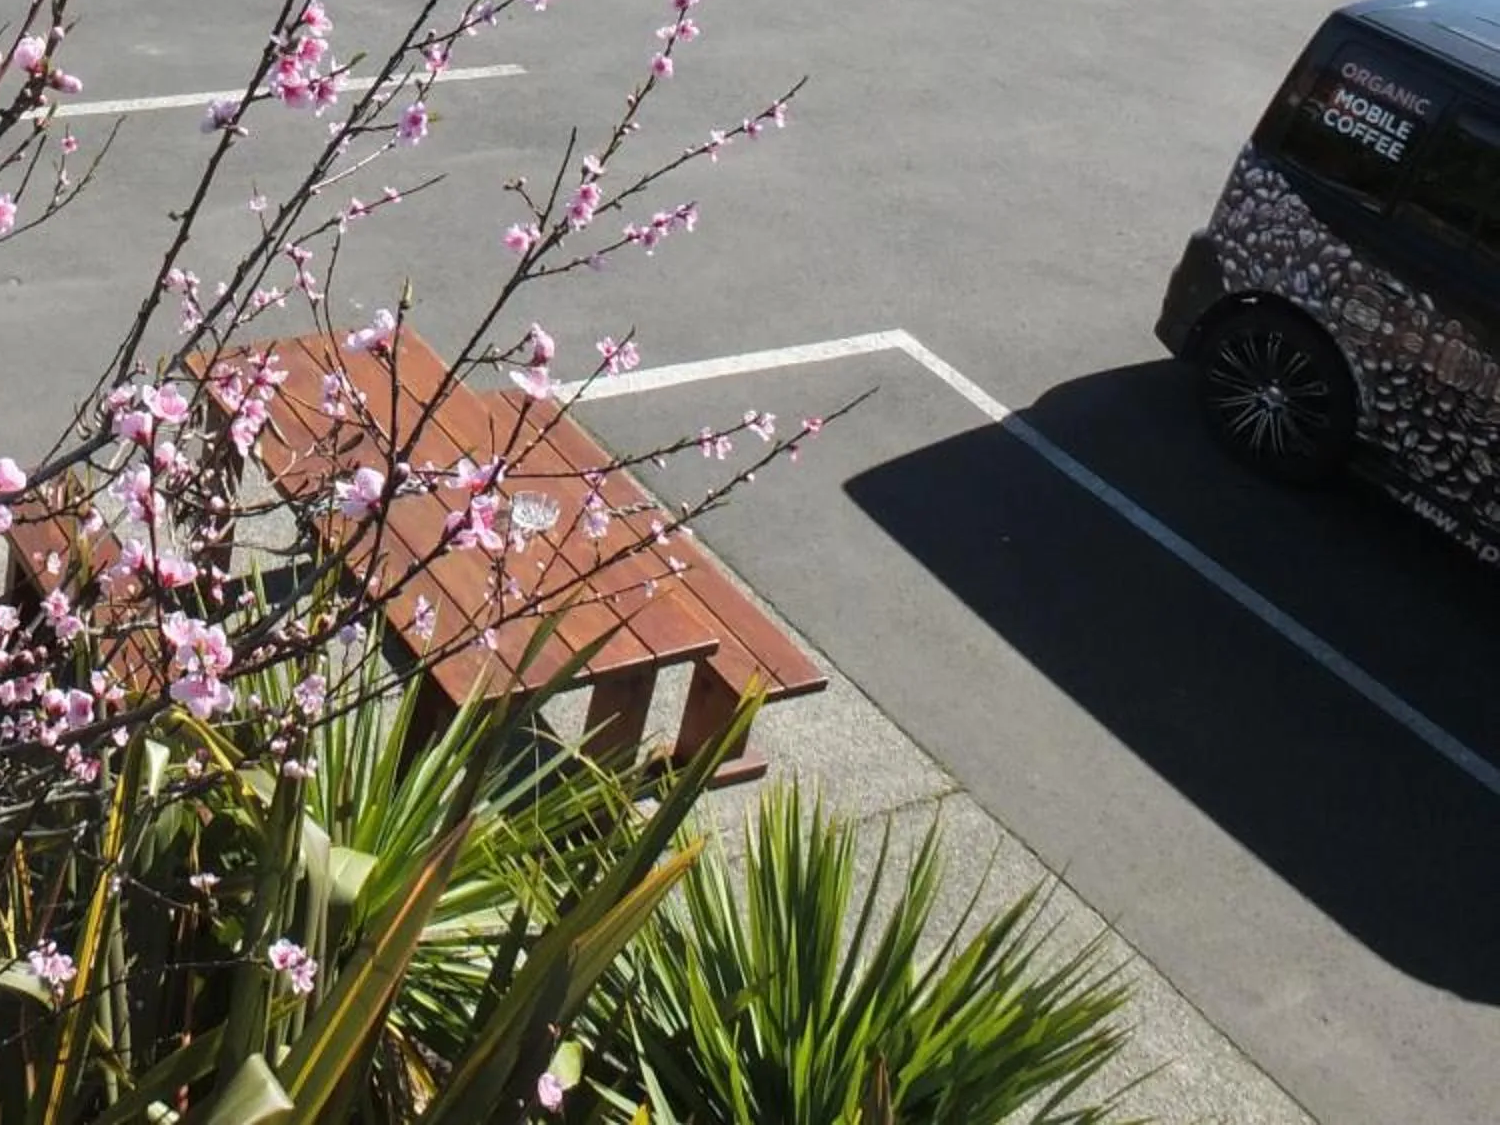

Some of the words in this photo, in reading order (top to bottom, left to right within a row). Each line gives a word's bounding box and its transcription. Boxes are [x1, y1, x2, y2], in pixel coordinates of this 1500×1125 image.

[1333, 88, 1414, 141] MOBILE
[1341, 62, 1431, 115] ORGANIC
[1322, 107, 1406, 163] COFFEE
